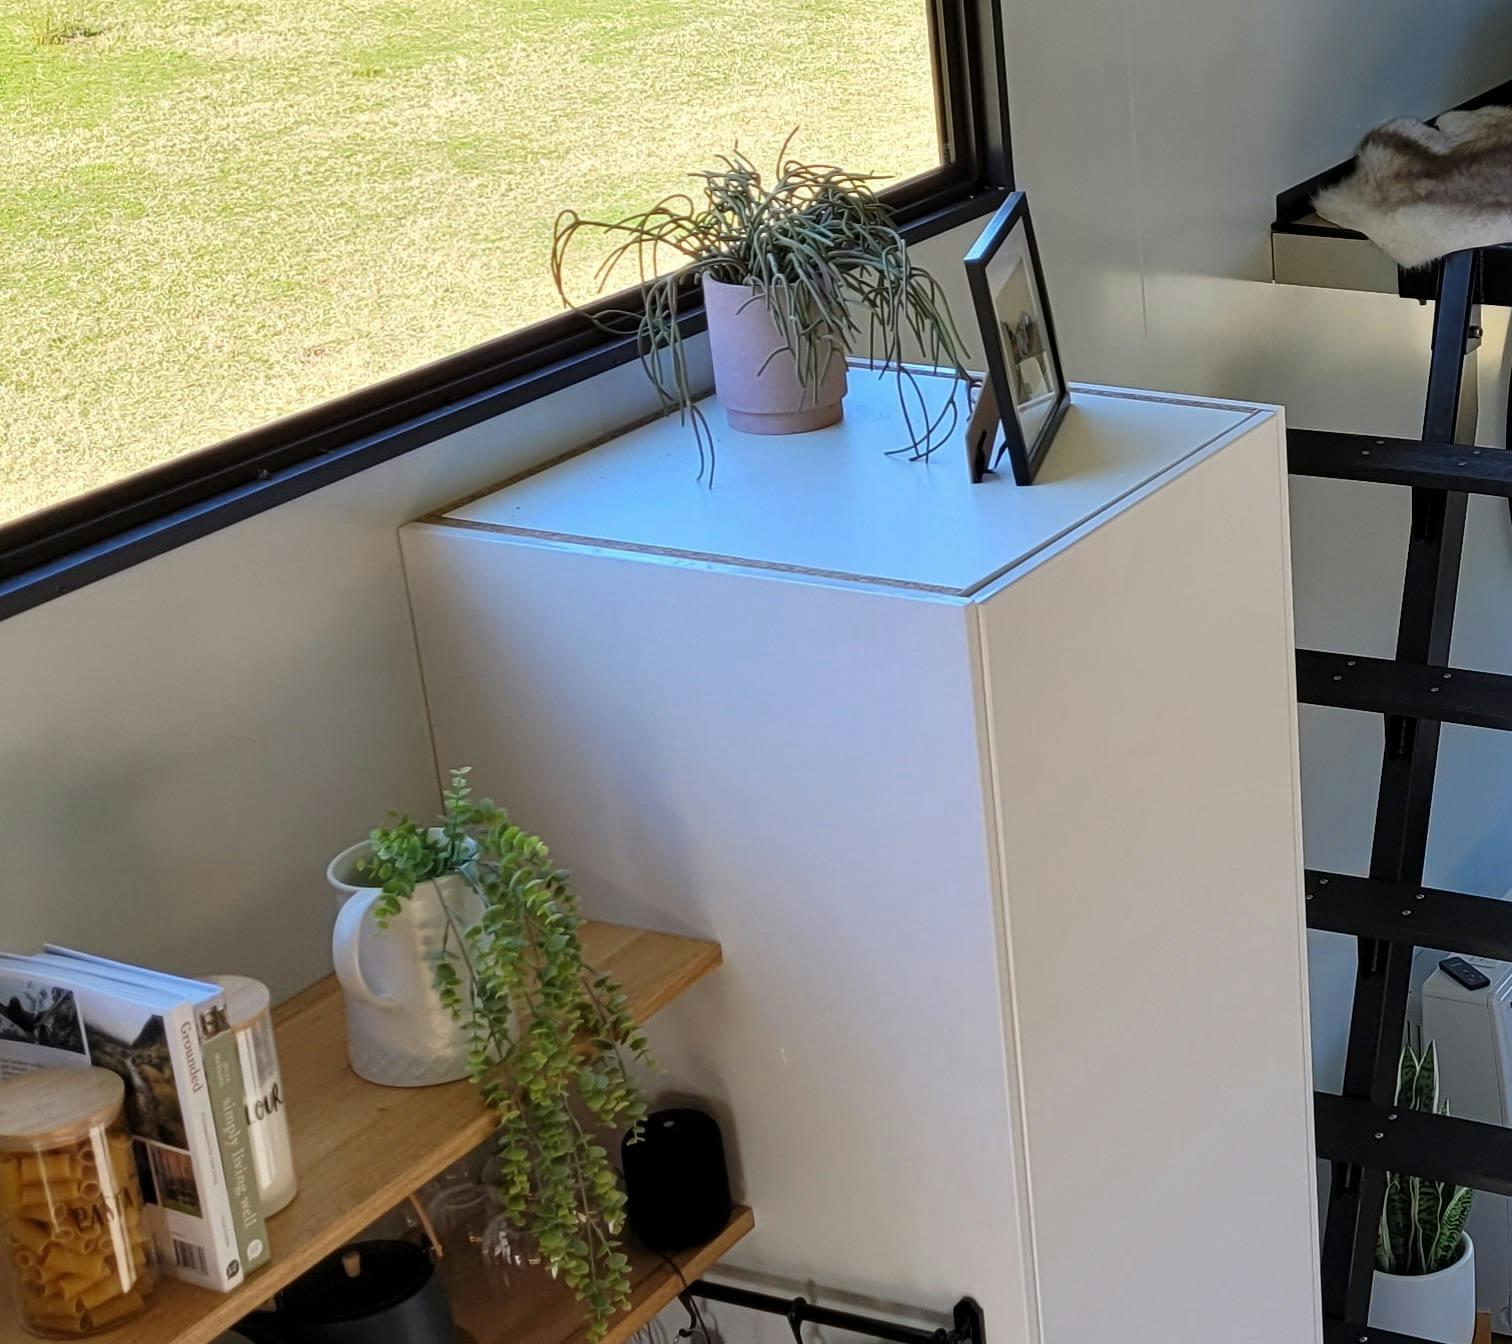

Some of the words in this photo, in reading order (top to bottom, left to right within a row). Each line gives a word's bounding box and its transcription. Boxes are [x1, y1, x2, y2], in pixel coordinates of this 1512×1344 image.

[179, 1020, 202, 1094] Grounded
[222, 1097, 242, 1151] simply
[244, 1082, 284, 1126] LOUR
[230, 1149, 250, 1201] living
[239, 1194, 259, 1229] well
